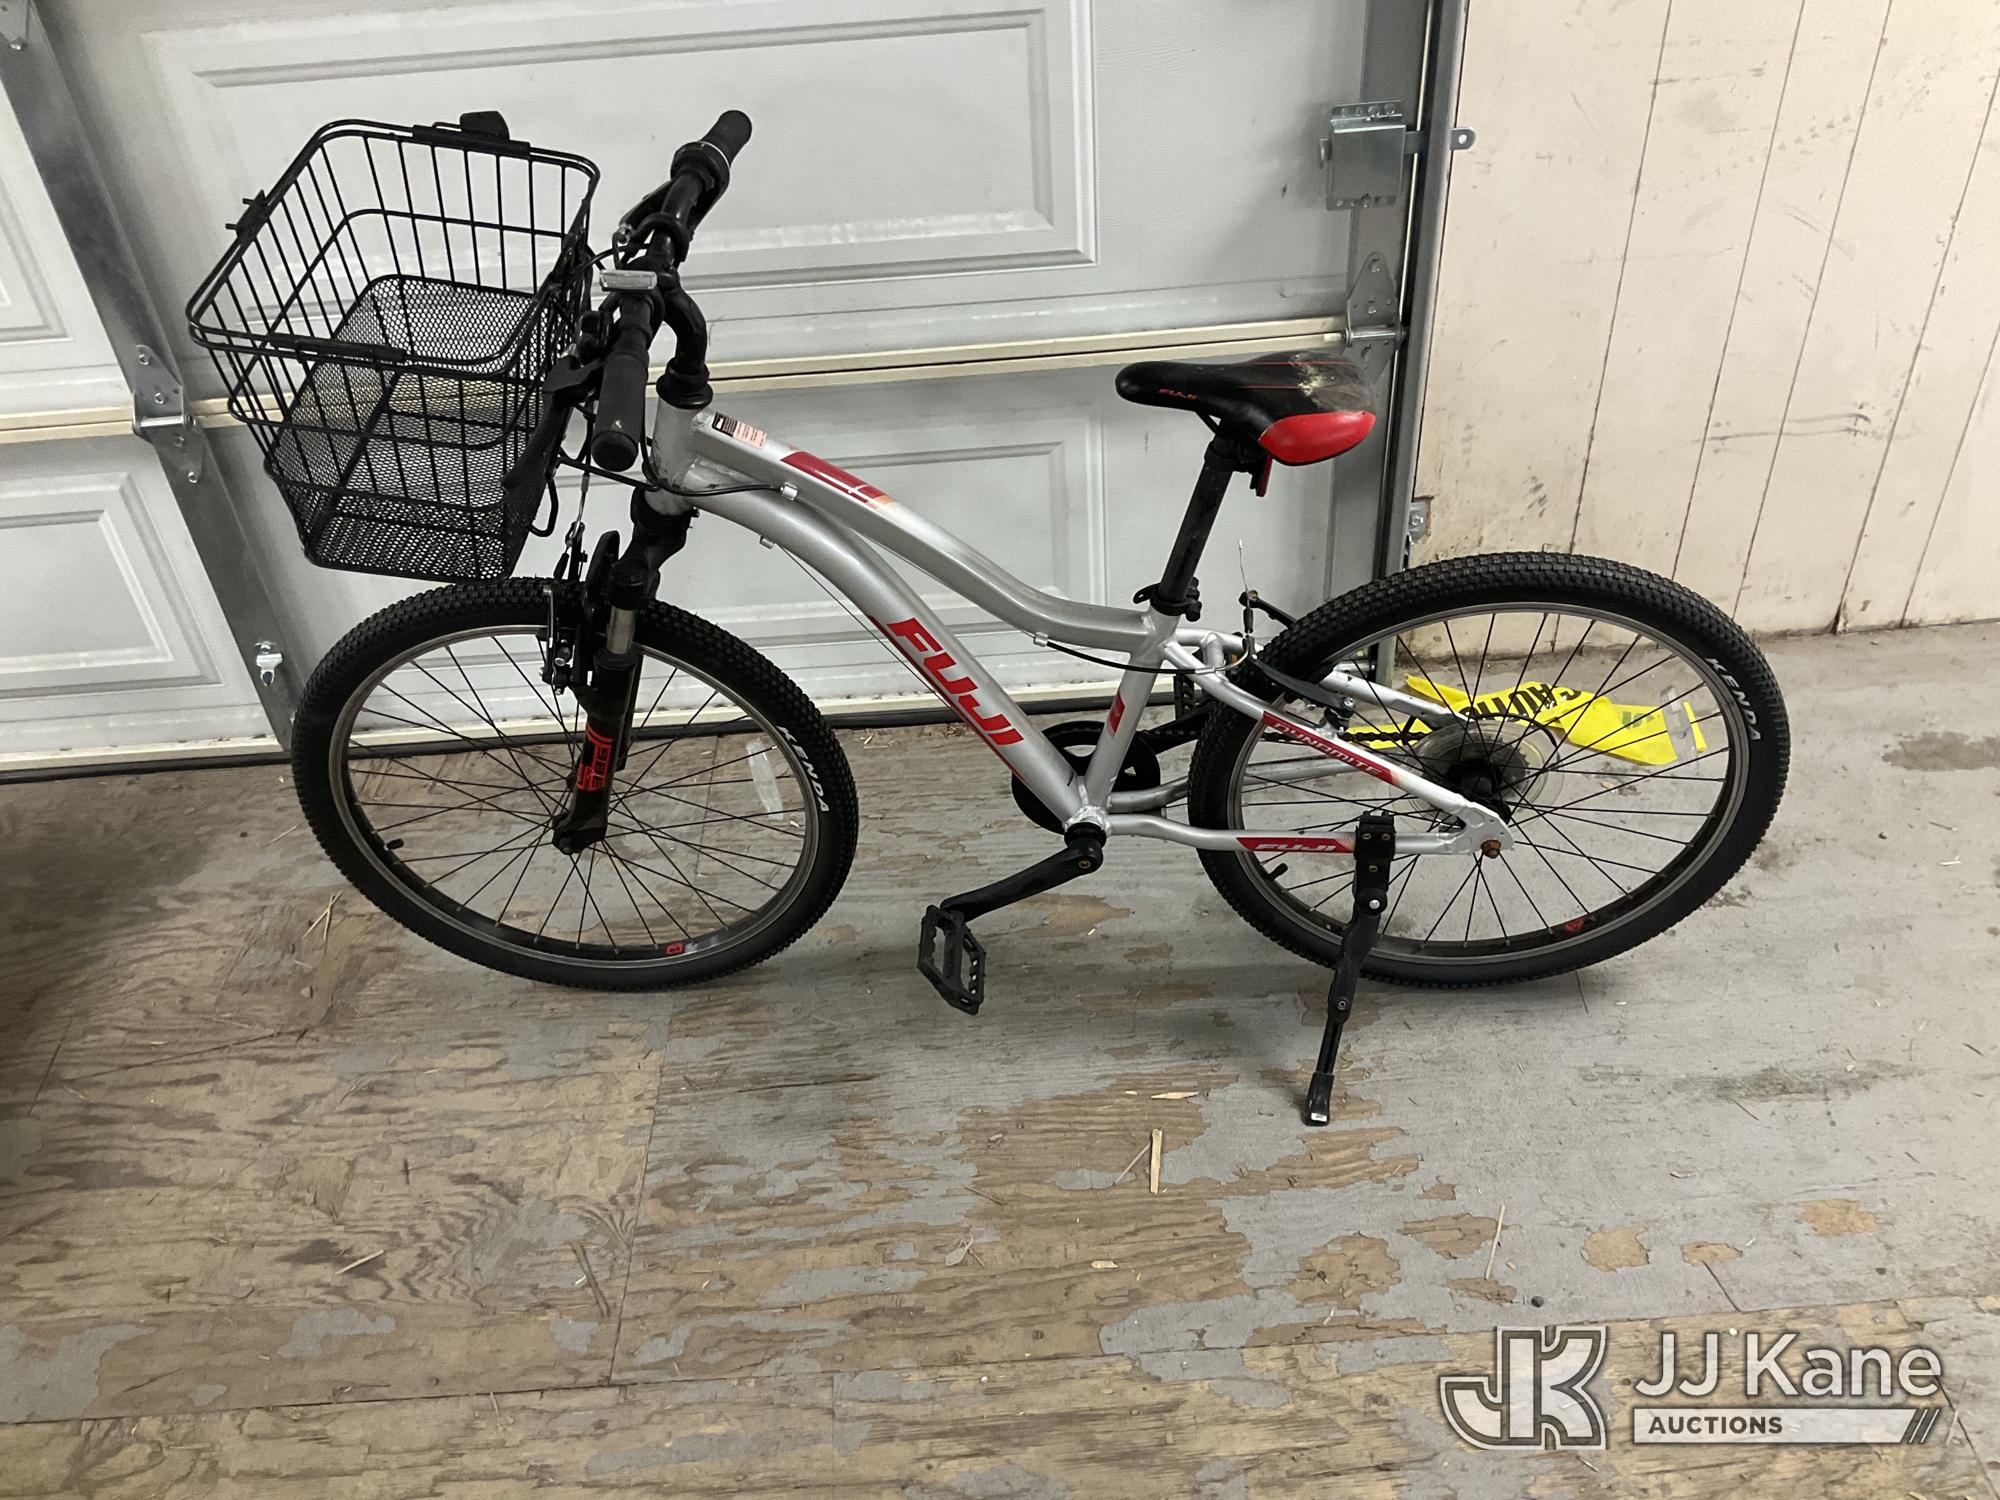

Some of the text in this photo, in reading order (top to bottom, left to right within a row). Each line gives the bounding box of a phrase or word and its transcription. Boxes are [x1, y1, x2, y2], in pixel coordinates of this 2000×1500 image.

[887, 617, 1024, 746] FUJI
[1704, 658, 1761, 740] KENDA
[775, 726, 830, 812] KENDA
[1273, 722, 1383, 777] DYNAMITE
[1255, 842, 1338, 853] FUJI
